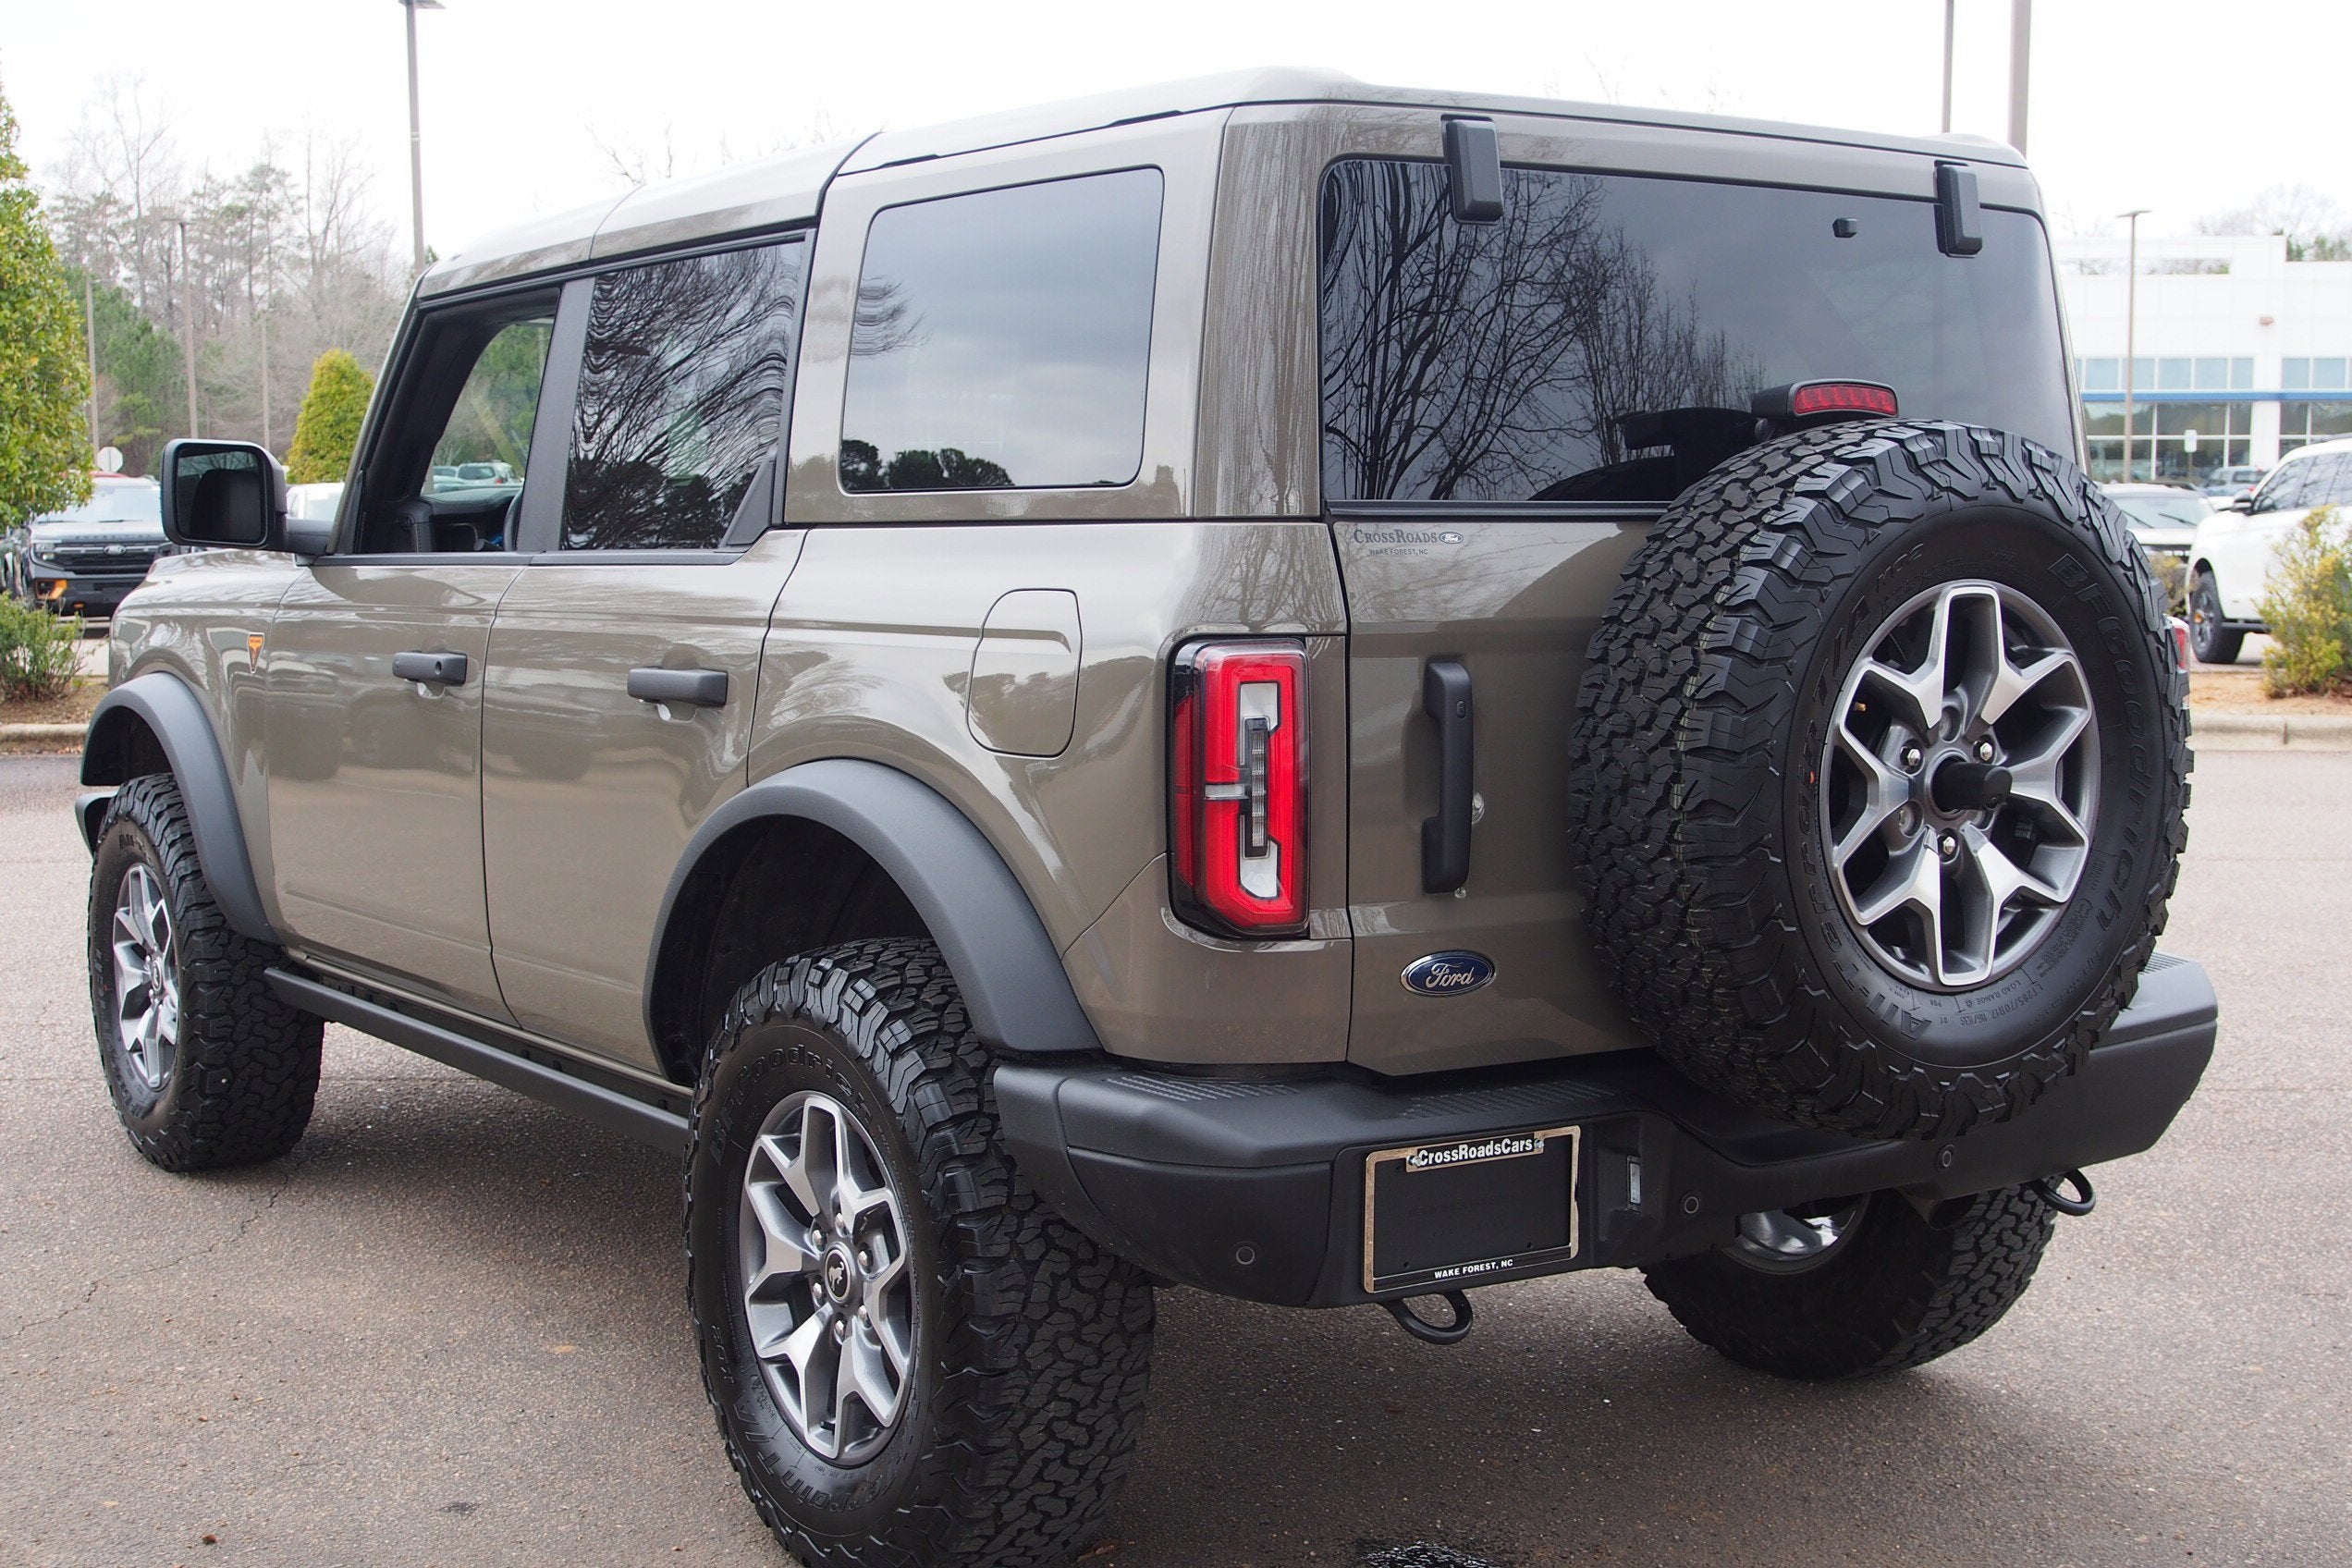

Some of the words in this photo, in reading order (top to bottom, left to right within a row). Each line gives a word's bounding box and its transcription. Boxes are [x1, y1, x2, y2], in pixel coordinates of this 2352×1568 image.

[2048, 553, 2152, 932] BFGoodrich
[1426, 962, 1475, 988] Ford
[710, 1044, 873, 1166] BFGoodrich
[1418, 1137, 1533, 1167] CrossRoadsCars
[1434, 1267, 1461, 1279] WAKE
[1462, 1261, 1500, 1276] FOREST,
[1501, 1258, 1514, 1268] NC
